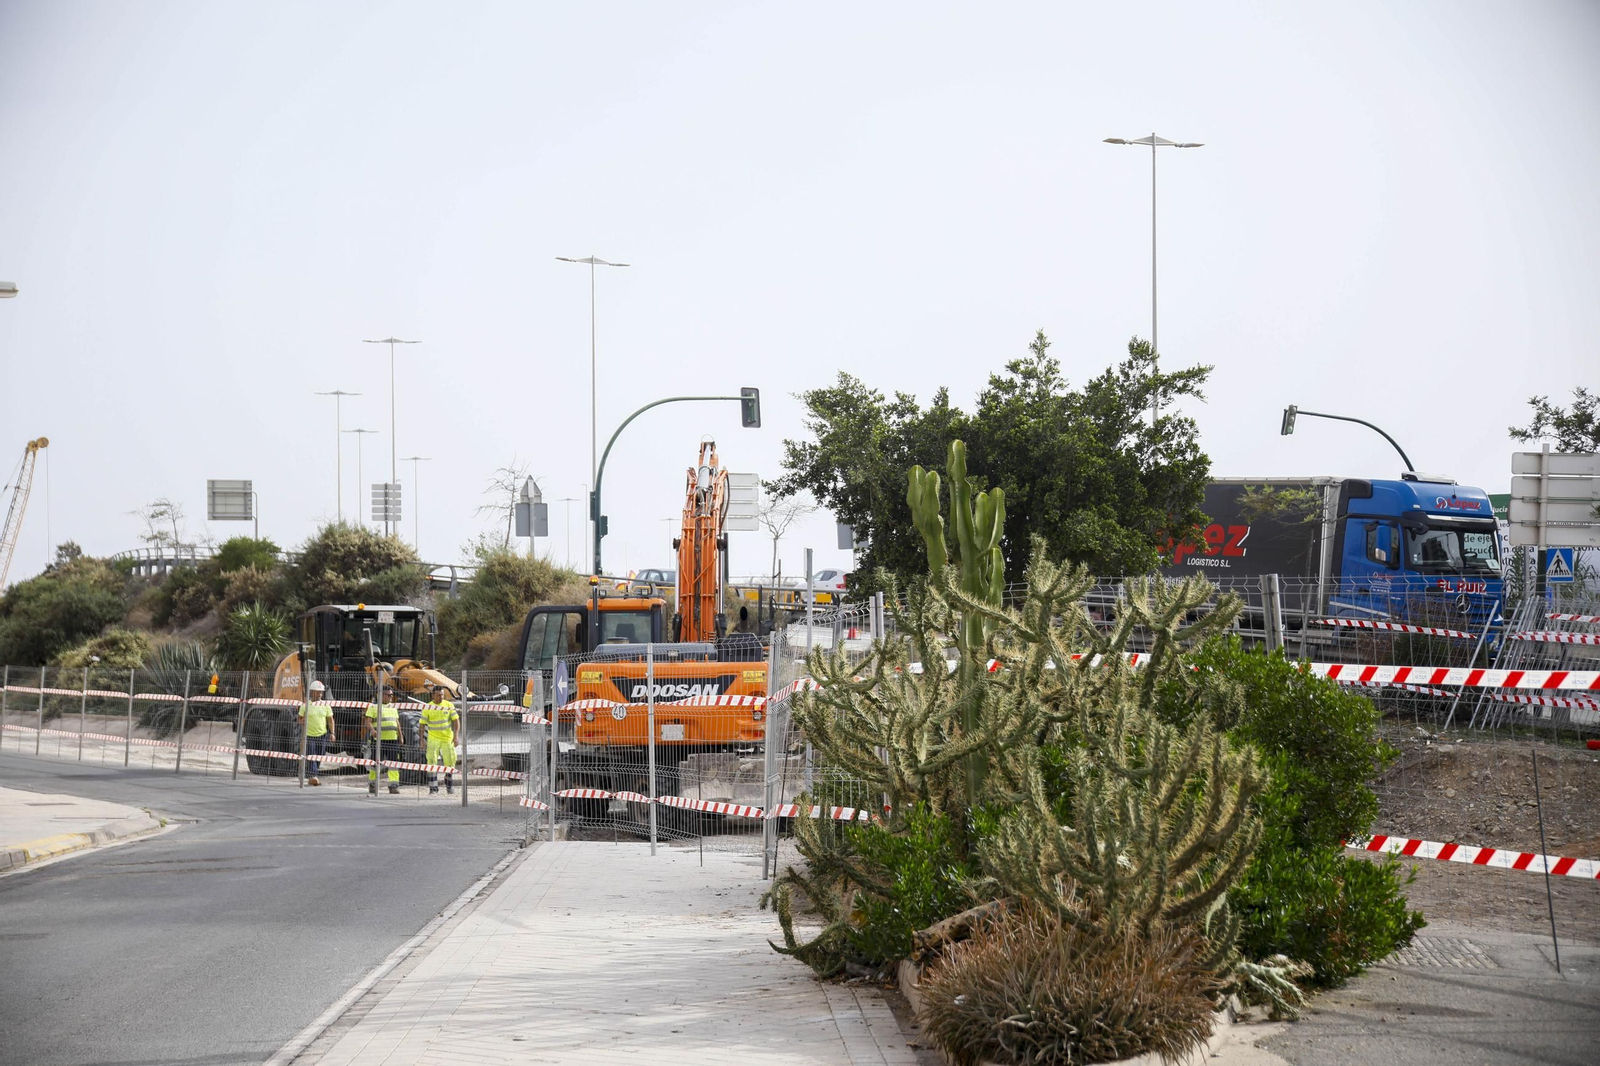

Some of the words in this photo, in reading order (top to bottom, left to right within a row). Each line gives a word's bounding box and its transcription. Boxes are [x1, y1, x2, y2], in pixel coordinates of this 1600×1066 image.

[1187, 558, 1219, 567] LOGISTICO
[1220, 559, 1231, 568] S.L.
[1437, 579, 1455, 593] EL
[1457, 580, 1487, 595] RUIZ
[281, 676, 300, 688] CASE
[631, 684, 719, 697] DOOSAN
[613, 706, 626, 719] 40
